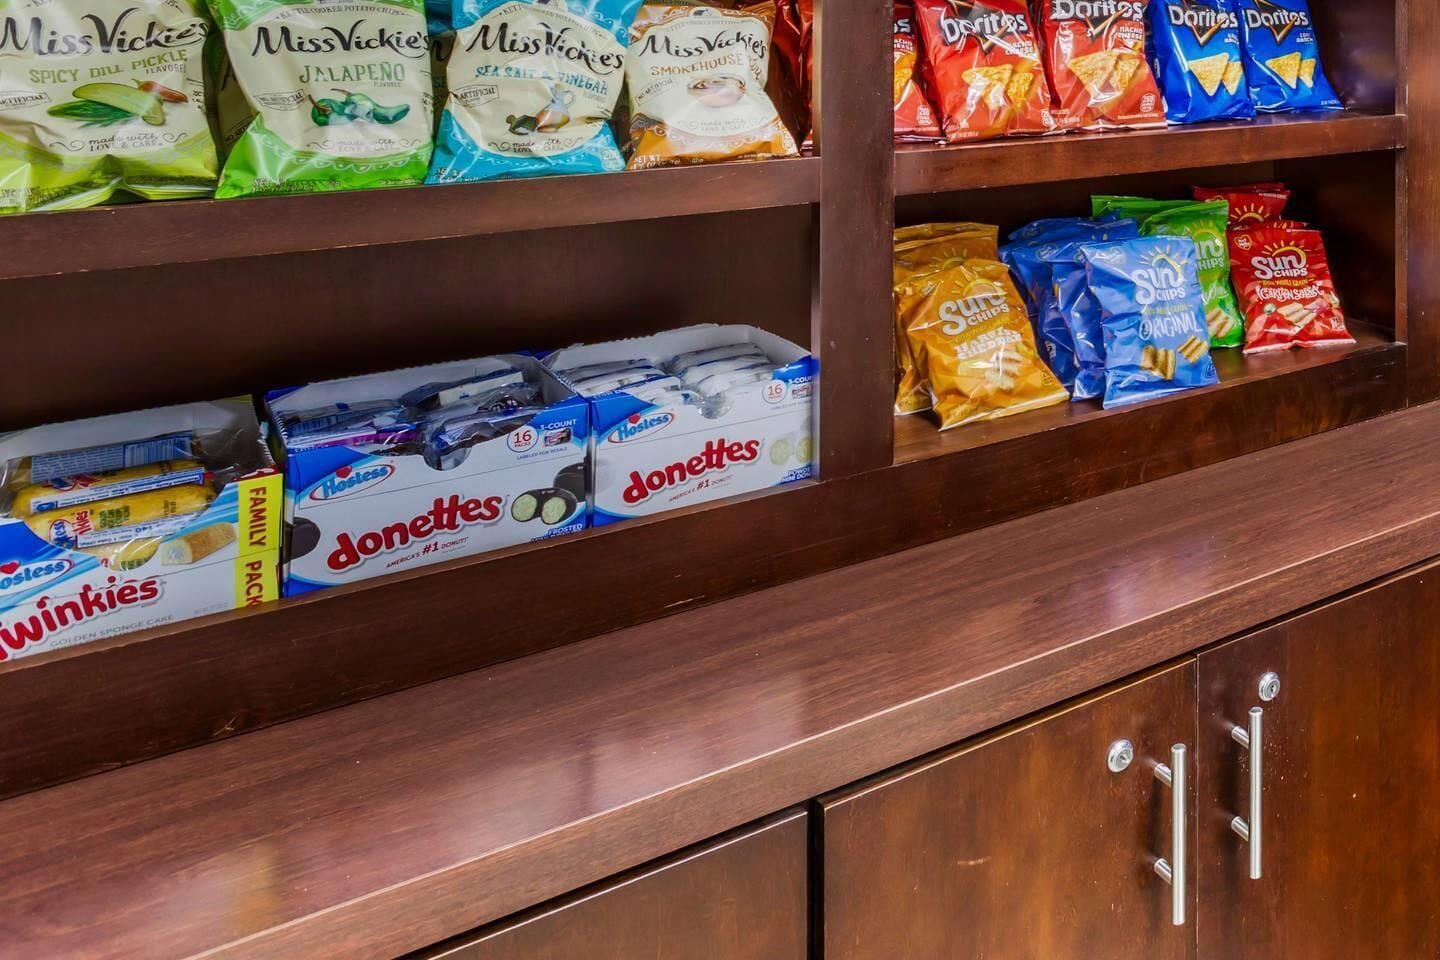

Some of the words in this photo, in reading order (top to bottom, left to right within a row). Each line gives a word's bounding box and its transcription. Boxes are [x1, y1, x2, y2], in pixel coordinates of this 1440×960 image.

[942, 13, 1028, 44] Doritos
[1119, 26, 1143, 34] NACHO
[1168, 5, 1238, 28] Doritos
[1247, 9, 1309, 28] Doritos
[0, 16, 94, 56] Miss
[80, 7, 209, 55] Vickie's
[252, 25, 336, 57] Miss
[320, 19, 430, 58] Vickie's
[465, 22, 542, 55] Miss
[639, 34, 704, 58] Miss
[696, 29, 768, 59] Vickie's
[1117, 32, 1144, 41] CHEESE
[29, 69, 80, 85] SPICY
[89, 64, 124, 79] DILL
[131, 49, 189, 71] PICKLE
[299, 61, 406, 84] JALAPEÑO
[475, 64, 501, 78] SEA
[650, 52, 745, 77] SMOKEHOUSE
[1251, 254, 1307, 280] Sun
[1273, 267, 1308, 278] CHIPS
[1131, 266, 1184, 305] Sun
[967, 303, 1010, 326] CHIPS
[767, 383, 783, 396] 16
[513, 430, 532, 444] 16
[617, 413, 670, 441] Hostess
[321, 465, 389, 499] Hostess
[623, 438, 760, 504] donettes
[696, 478, 710, 491] #1
[248, 485, 267, 548] FAMILY
[327, 494, 503, 571] donettes
[386, 552, 421, 569] AMERICA'S
[421, 541, 439, 556] #1
[0, 560, 66, 590] ostess
[245, 559, 265, 608] PACK
[50, 631, 98, 647] GOLDEN
[100, 621, 144, 636] SPONGE
[145, 614, 173, 627] CAKE
